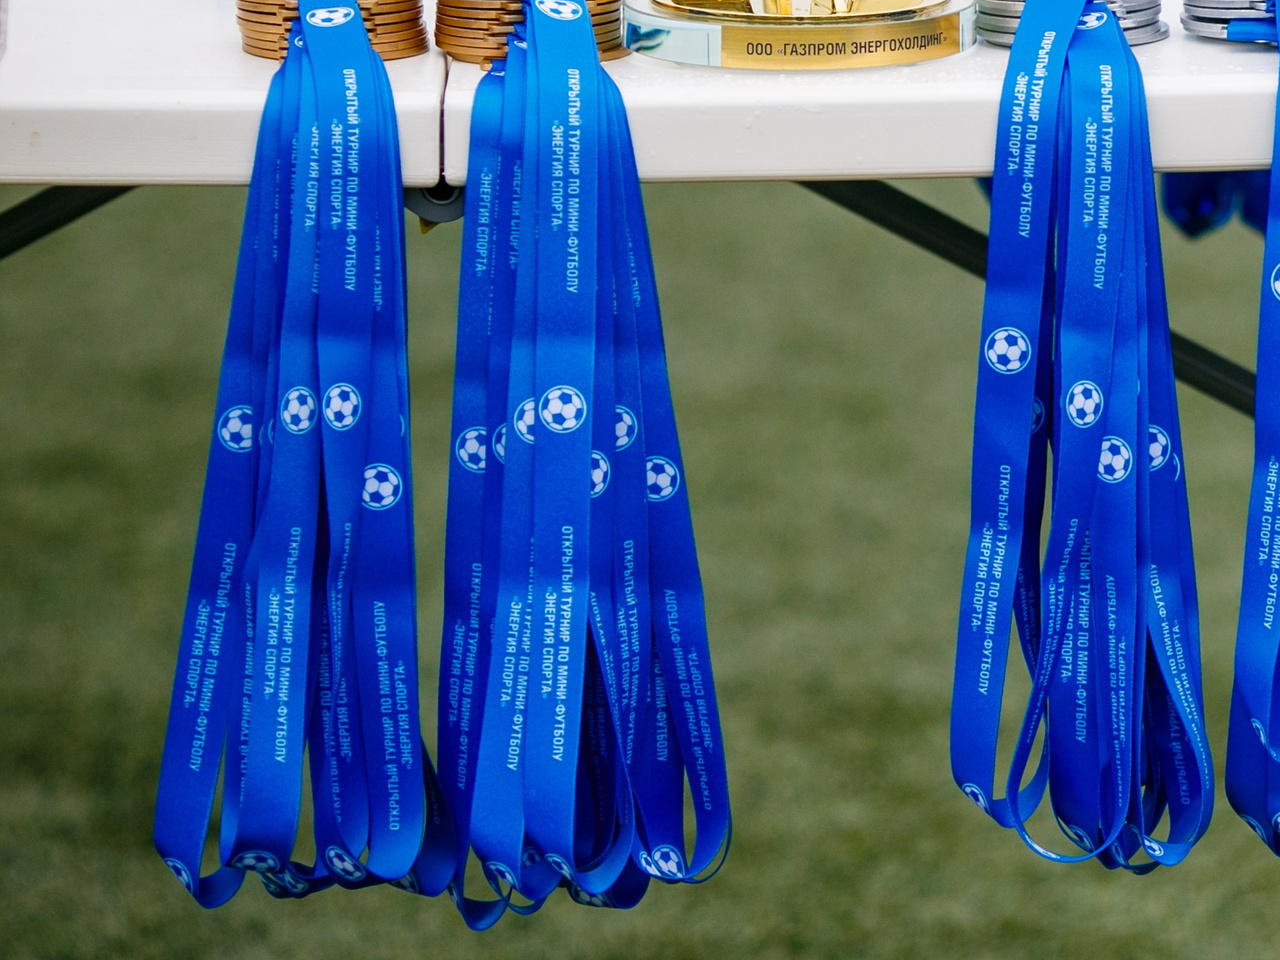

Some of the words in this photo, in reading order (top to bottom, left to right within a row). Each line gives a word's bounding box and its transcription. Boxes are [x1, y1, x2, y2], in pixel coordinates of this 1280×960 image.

[746, 41, 773, 56] ООО
[776, 40, 847, 57] «ГАЗПРОМ
[850, 31, 948, 55] ЭНЕРГОХОЛДИНГ»
[1034, 32, 1055, 77] ОТКРЫТЫЙ
[343, 69, 360, 124] ОТКРЫТЫЙ
[567, 69, 582, 125] ОТКРЫТЫЙ
[1012, 72, 1029, 122] «ЭНЕРГИЯ
[1028, 79, 1044, 121] ТУРНИР
[1100, 65, 1115, 123] ОТКРЫТЫЙ
[331, 119, 343, 175] «ЭНЕРГИЯ
[348, 128, 359, 173] ТУРНИР
[552, 120, 564, 177] «ЭНЕРГИЯ
[568, 129, 580, 175] ТУРНИР
[1008, 125, 1021, 175] СПОРТА»
[1026, 125, 1038, 140] ПО
[1085, 117, 1097, 174] «ЭНЕРГИЯ
[1101, 127, 1113, 172] ТУРНИР
[331, 179, 342, 229] СПОРТА»
[347, 177, 358, 192] ПО
[551, 181, 563, 231] СПОРТА»
[568, 179, 580, 194] ПО
[1019, 144, 1036, 238] МИНИ-ФУТБОЛУ
[1083, 177, 1095, 227] СПОРТА»
[1100, 176, 1111, 191] ПО
[345, 196, 357, 290] МИНИ-ФУТБОЛУ
[567, 198, 579, 293] МИНИ-ФУТБОЛУ
[1094, 195, 1110, 289] МИНИ-ФУТБОЛУ
[998, 465, 1010, 530] ОТКРЫТЫЙ
[216, 543, 236, 608] ОТКРЫТЫЙ
[285, 527, 301, 594] ОТКРЫТЫЙ
[562, 526, 574, 593] ОТКРЫТЫЙ
[977, 523, 993, 578] «ЭНЕРГИЯ
[992, 535, 1007, 579] ТУРНИР
[972, 582, 985, 631] СПОРТА»
[989, 582, 1000, 597] ПО
[209, 612, 226, 656] ТУРНИР
[267, 588, 280, 645] «ЭНЕРГИЯ
[283, 598, 295, 644] ТУРНИР
[544, 587, 557, 644] «ЭНЕРГИЯ
[559, 597, 572, 642] ТУРНИР
[205, 659, 218, 675] ПО
[280, 648, 292, 663] ПО
[541, 648, 554, 698] СПОРТА»
[558, 646, 569, 661] ПО
[979, 601, 997, 695] МИНИ-ФУТБОЛУ
[264, 649, 277, 699] СПОРТА»
[190, 678, 214, 771] МИНИ-ФУТБОЛУ
[275, 667, 290, 762] МИНИ-ФУТБОЛУ
[552, 666, 568, 761] МИНИ-ФУТБОЛУ
